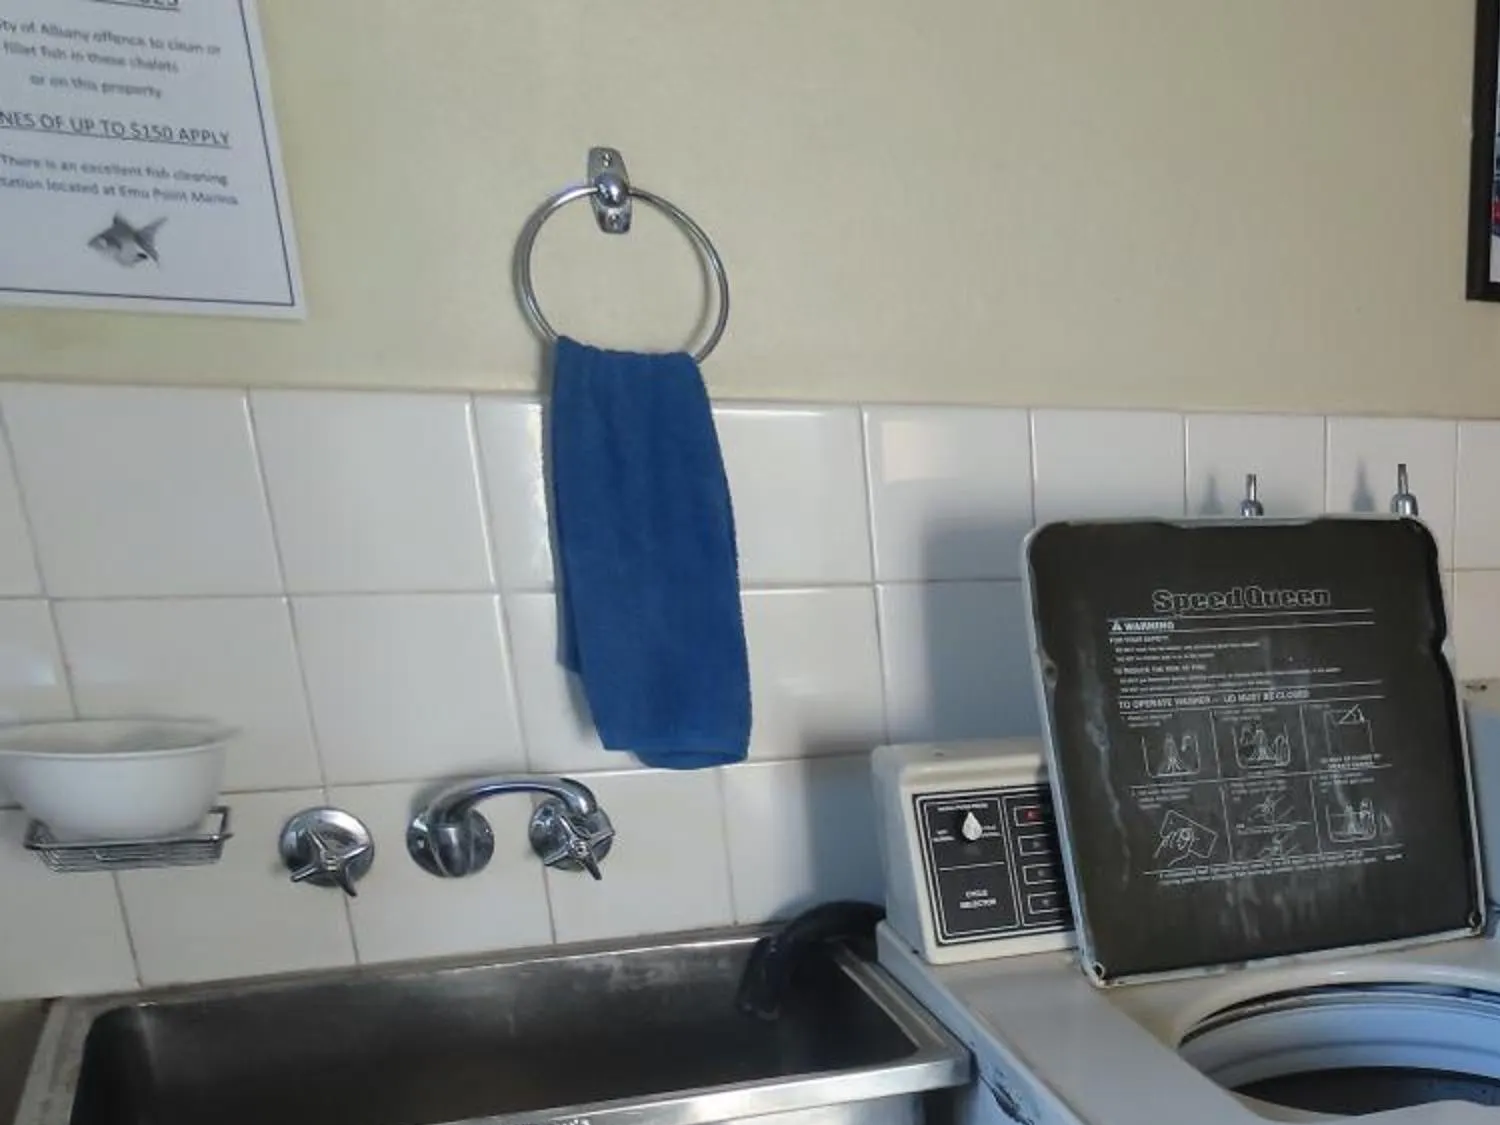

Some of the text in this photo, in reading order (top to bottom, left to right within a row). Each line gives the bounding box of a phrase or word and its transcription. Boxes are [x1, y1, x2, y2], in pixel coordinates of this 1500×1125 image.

[149, 36, 164, 49] to
[41, 45, 67, 60] fish
[49, 77, 69, 89] on
[71, 77, 98, 92] this
[40, 113, 63, 130] OF
[69, 116, 96, 133] UP
[101, 119, 126, 138] TO
[130, 121, 174, 141] $150
[179, 126, 231, 145] APPLY
[61, 161, 77, 173] an
[1151, 585, 1332, 616] Speed Queen
[1123, 620, 1175, 631] WARNING
